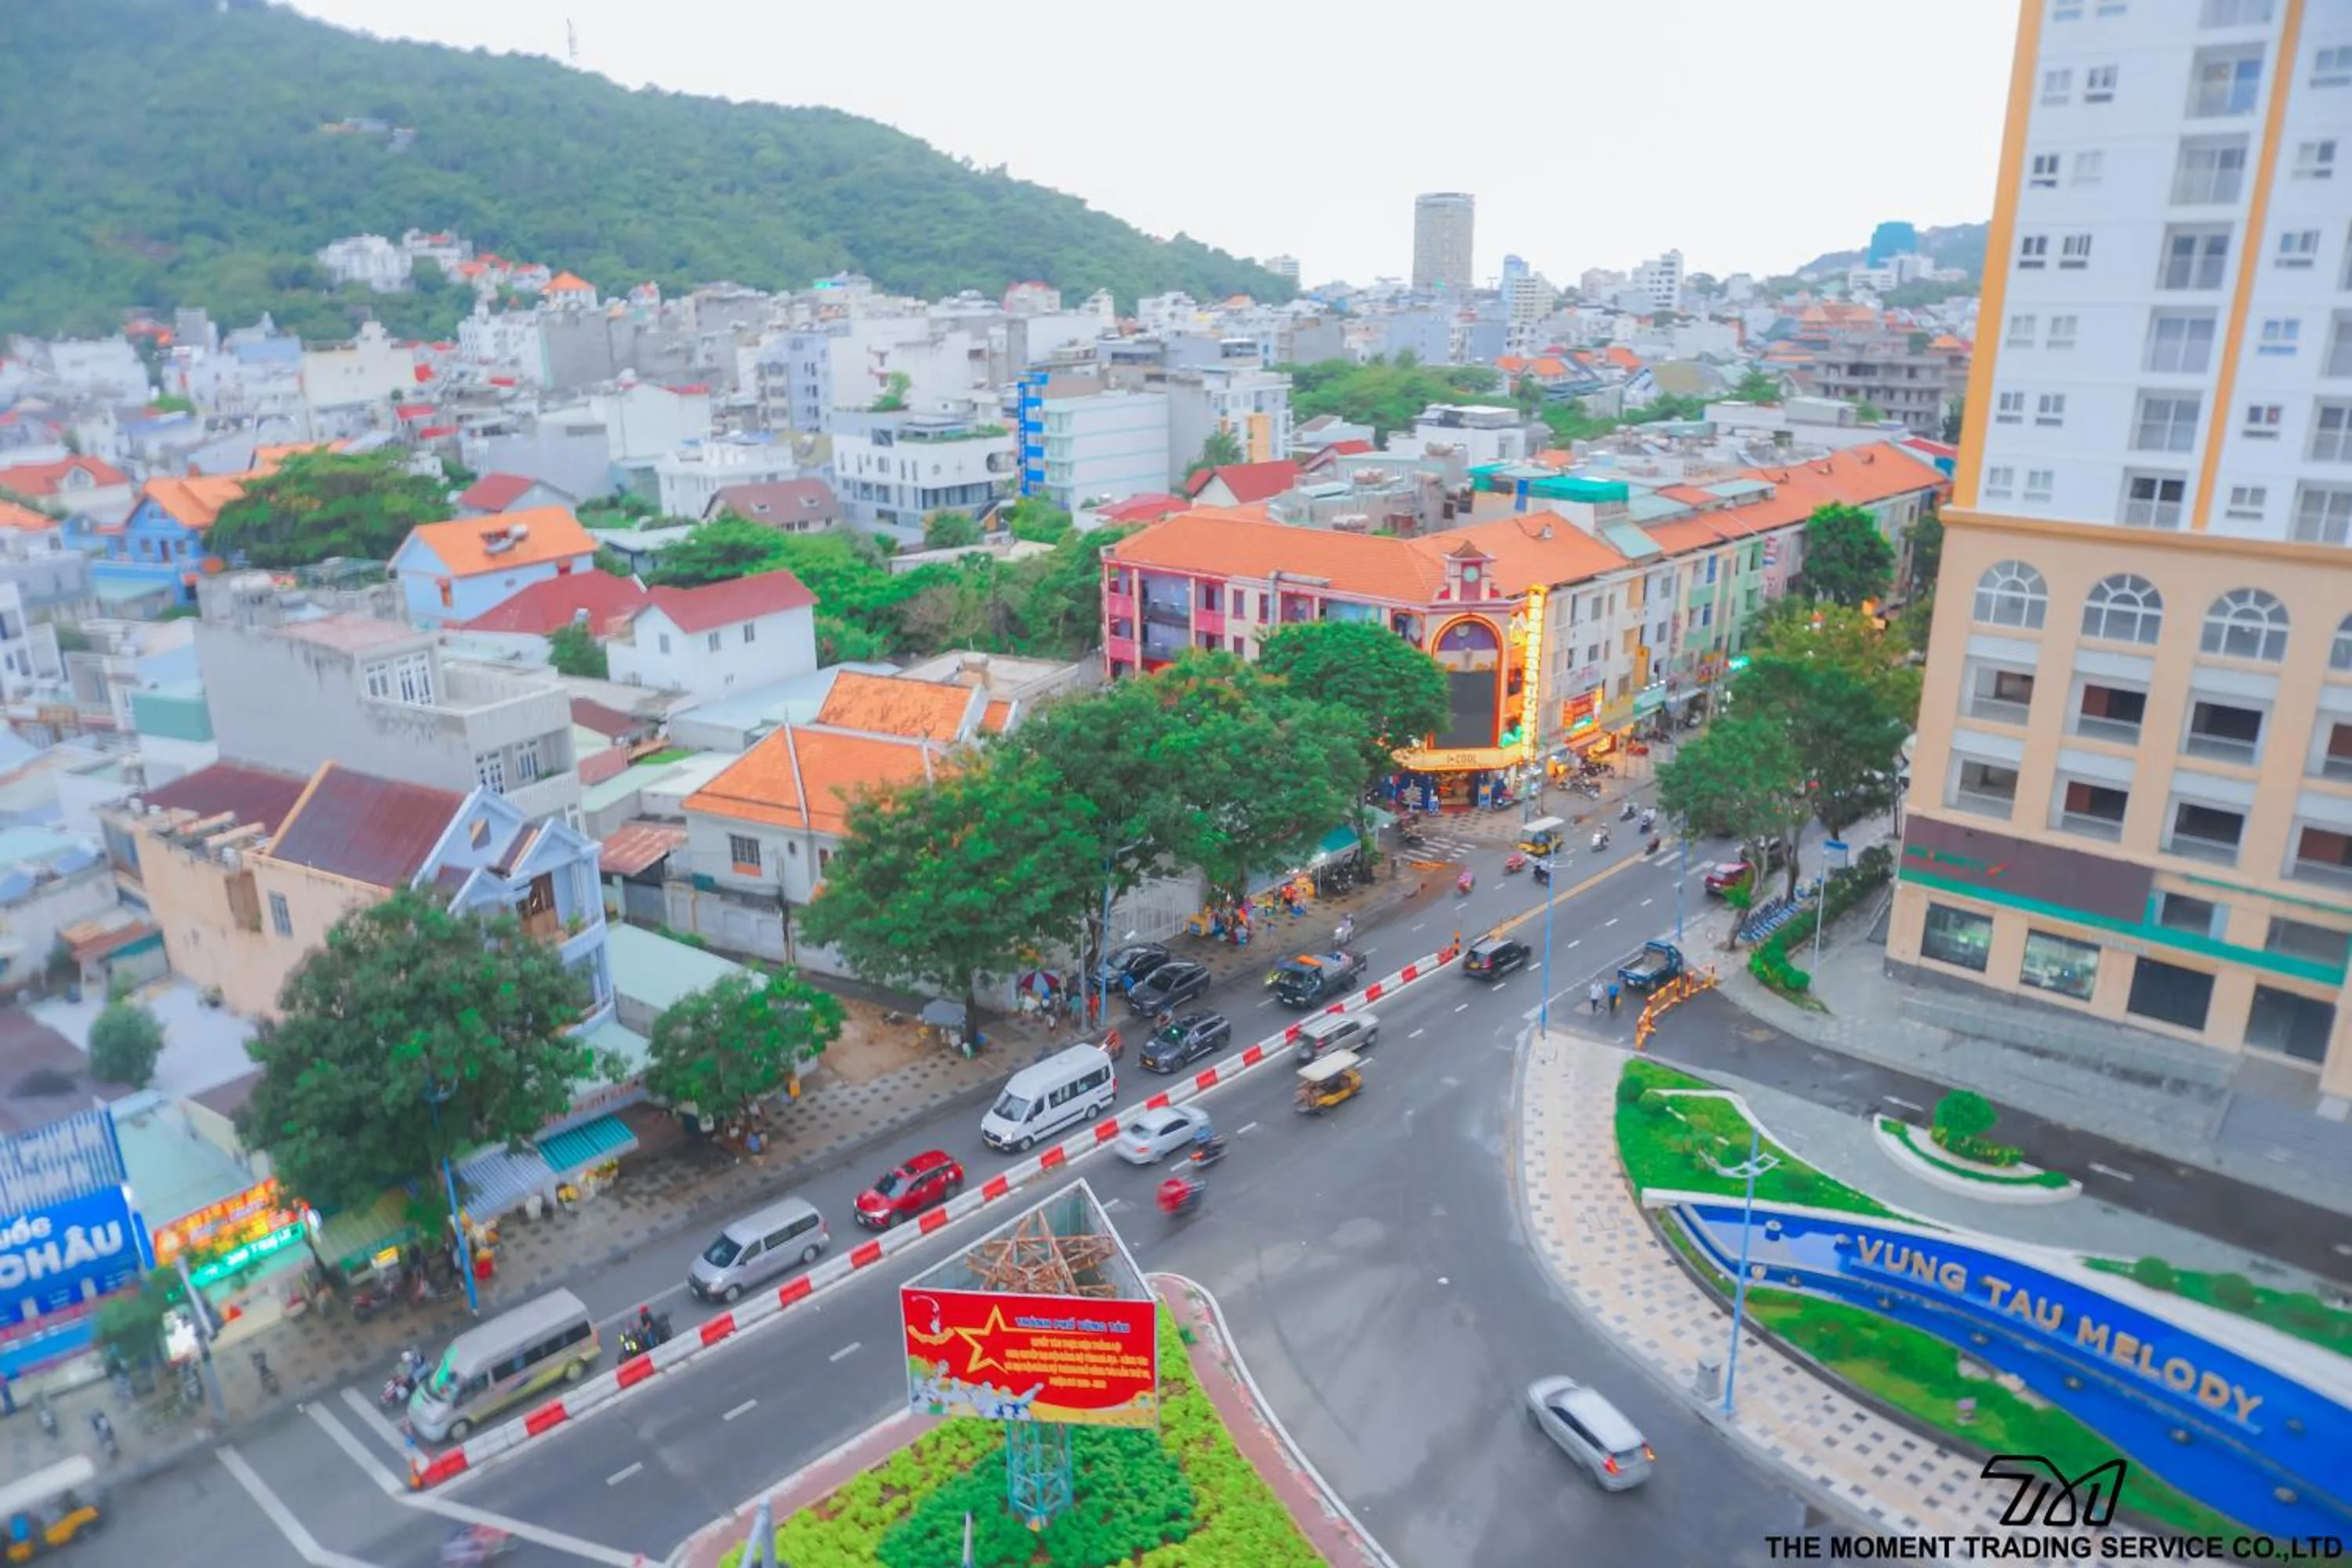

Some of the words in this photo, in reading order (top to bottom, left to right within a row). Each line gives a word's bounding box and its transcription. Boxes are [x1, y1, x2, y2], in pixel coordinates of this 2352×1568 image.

[1857, 1235, 1968, 1293] VUNG
[1982, 1274, 2063, 1331] TAU
[2078, 1316, 2264, 1423] MELODY
